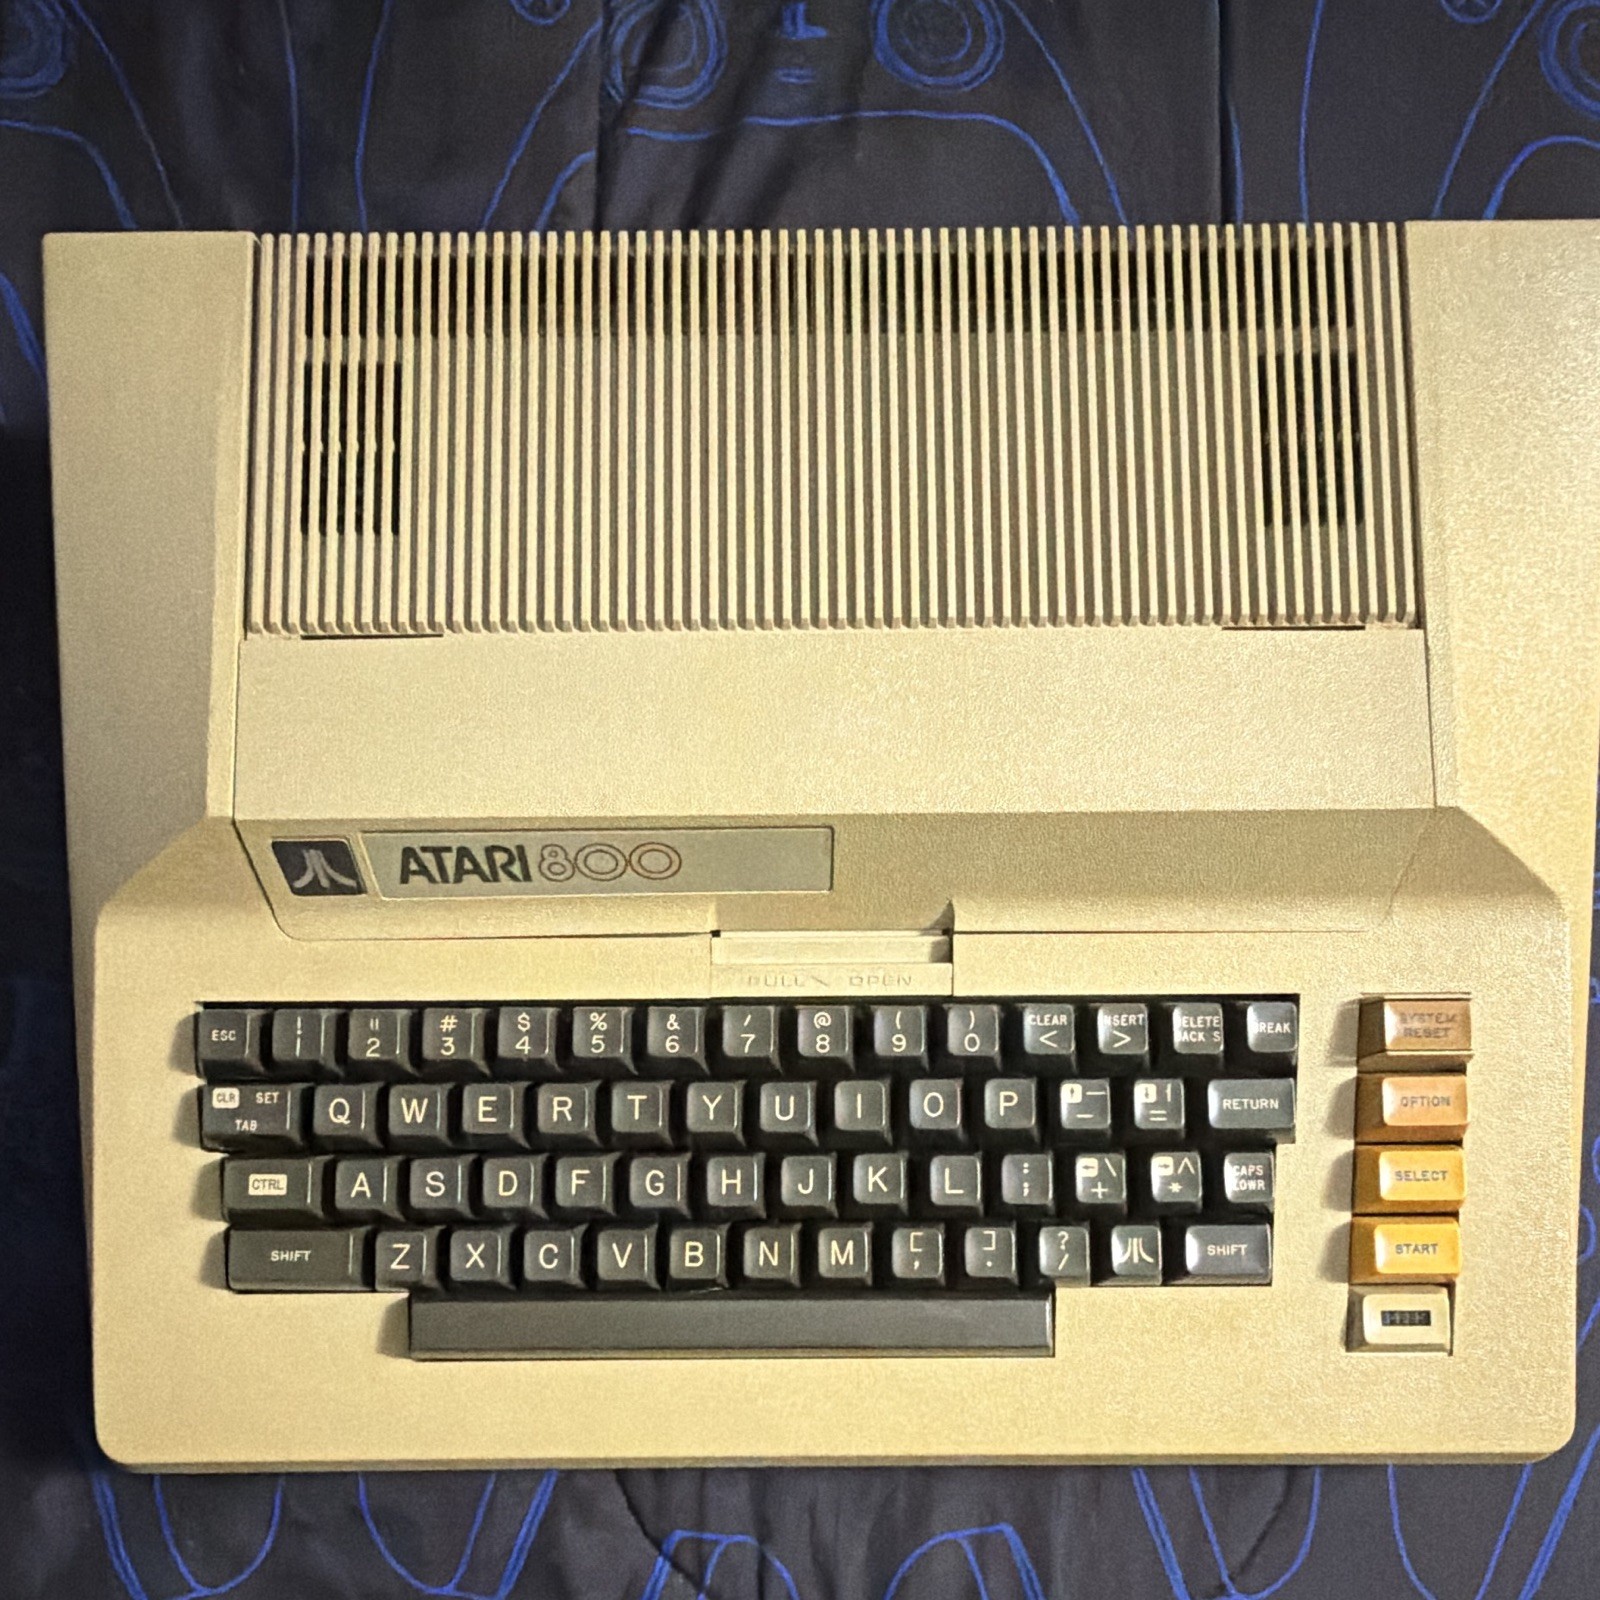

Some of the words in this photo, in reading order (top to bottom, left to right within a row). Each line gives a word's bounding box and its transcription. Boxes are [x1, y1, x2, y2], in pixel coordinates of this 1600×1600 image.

[400, 845, 532, 884] ATARI
[538, 841, 683, 882] 800
[850, 974, 912, 988] OPEN
[439, 1014, 458, 1033] #
[517, 1012, 531, 1033] $
[589, 1012, 608, 1032] %
[666, 1013, 681, 1031] &
[813, 1011, 832, 1029] @
[1028, 1014, 1068, 1026] CLEAR
[1101, 1014, 1144, 1027] NSERT
[211, 1029, 236, 1042] ESC
[740, 1033, 756, 1054] 7
[815, 1033, 831, 1054] 8
[891, 1033, 907, 1053] 9
[1038, 1030, 1058, 1048] <
[1111, 1028, 1132, 1048] >
[1176, 1031, 1206, 1043] ACK
[1403, 1027, 1451, 1039] RESET
[365, 1037, 381, 1058] 2
[440, 1036, 455, 1056] 3
[514, 1035, 532, 1055] 4
[590, 1034, 606, 1054] 5
[665, 1034, 680, 1054] 6
[216, 1092, 236, 1103] CLR
[255, 1091, 280, 1104] SET
[626, 1094, 648, 1121] T
[702, 1094, 722, 1121] Y
[774, 1095, 795, 1121] U
[923, 1091, 944, 1118] O
[999, 1090, 1019, 1117] P
[1222, 1098, 1279, 1111] RETURN
[1399, 1095, 1452, 1108] OPTION
[328, 1097, 351, 1125] Q
[400, 1097, 429, 1124] W
[477, 1095, 498, 1123] E
[552, 1096, 573, 1122] R
[234, 1119, 258, 1132] TAB
[867, 1165, 888, 1193] K
[944, 1167, 965, 1195] L
[1231, 1165, 1264, 1176] CAPS
[1394, 1169, 1449, 1182] SELECT
[251, 1177, 284, 1192] CTRL
[350, 1171, 371, 1198] A
[426, 1171, 445, 1197] S
[498, 1170, 518, 1197] D
[571, 1169, 591, 1196] F
[644, 1169, 665, 1197] G
[721, 1168, 742, 1195] H
[797, 1168, 814, 1195] J
[1090, 1181, 1109, 1199] +
[1057, 1230, 1069, 1251] ?
[1206, 1243, 1248, 1257] SHIFT
[1395, 1242, 1439, 1255] START
[270, 1249, 312, 1262] SHIFT
[390, 1243, 411, 1270] Z
[465, 1243, 485, 1269] X
[538, 1243, 559, 1270] C
[611, 1242, 633, 1269] V
[684, 1240, 704, 1268] B
[758, 1240, 779, 1267] N
[830, 1239, 854, 1266] M
